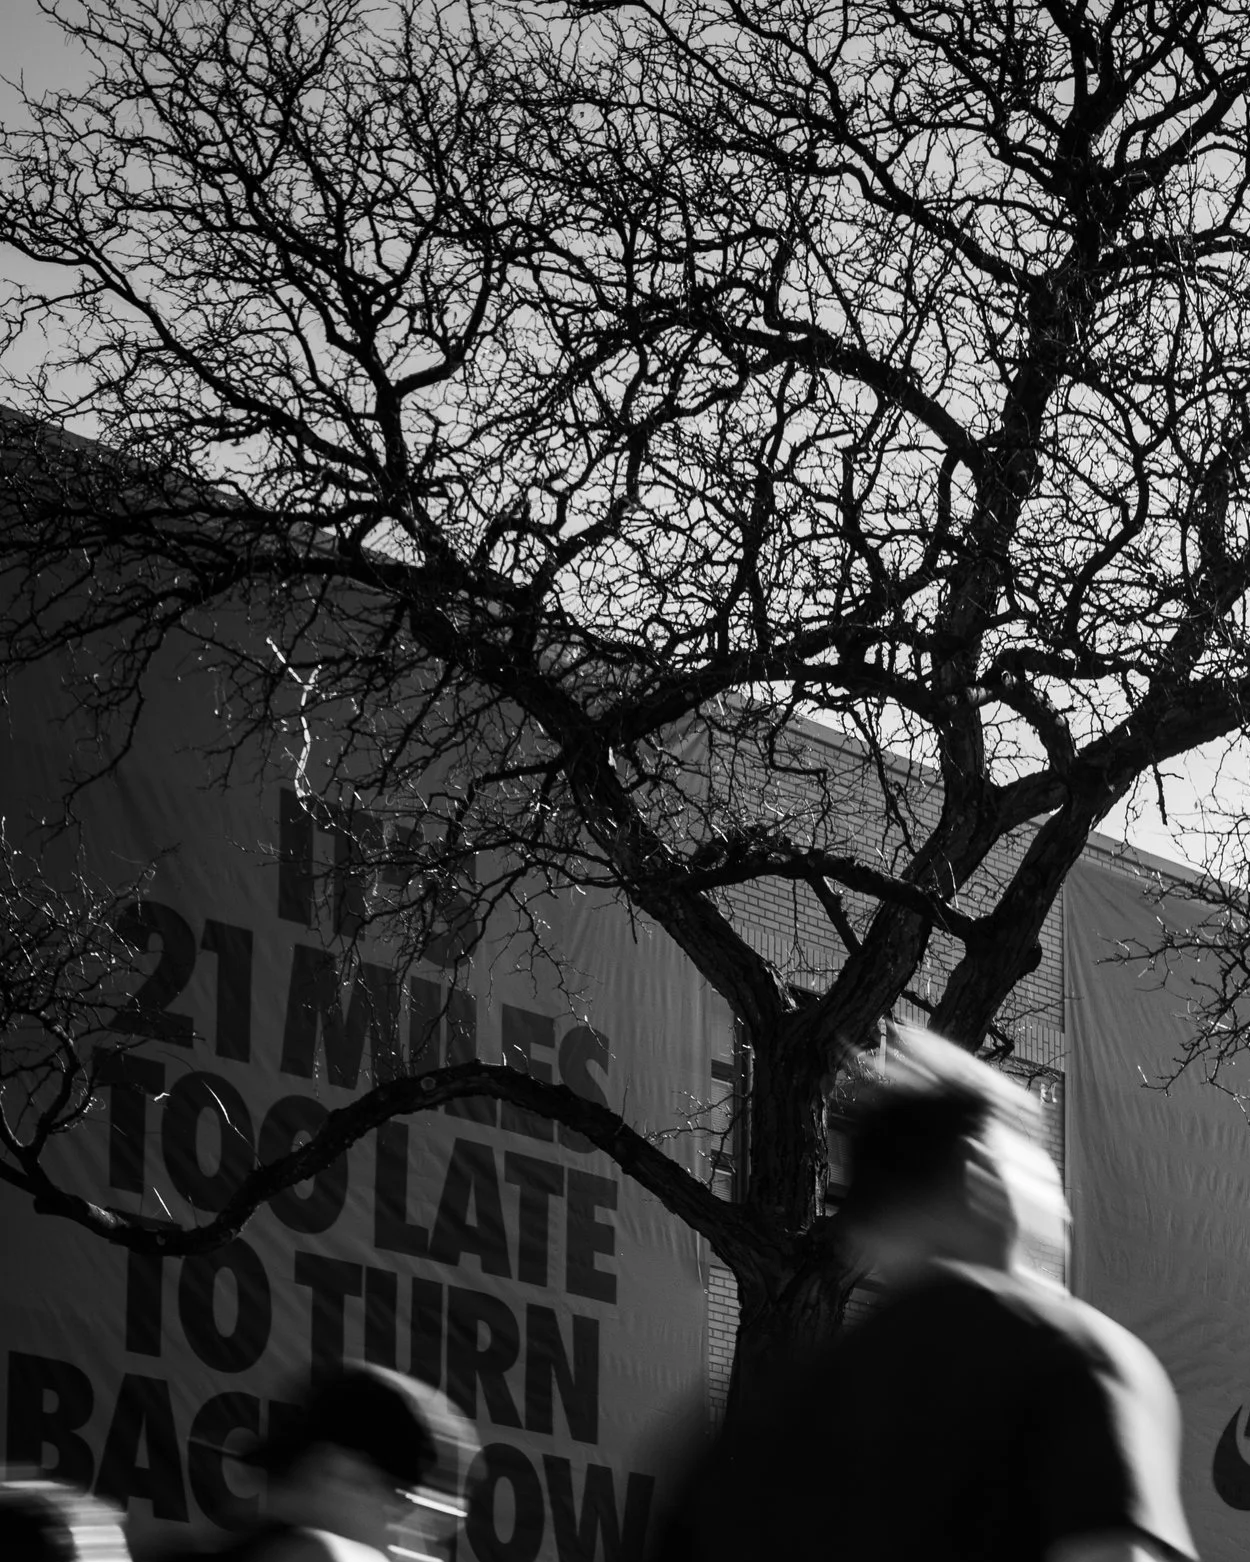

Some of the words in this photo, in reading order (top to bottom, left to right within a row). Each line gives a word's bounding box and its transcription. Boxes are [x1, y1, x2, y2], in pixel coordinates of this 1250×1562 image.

[109, 900, 253, 1064] 21
[280, 944, 610, 1154] MILES
[92, 1046, 348, 1234] TOO
[374, 1115, 619, 1304] LATE
[6, 1350, 302, 1532] BAC
[108, 1208, 272, 1373] TO
[294, 1250, 600, 1445] TURN
